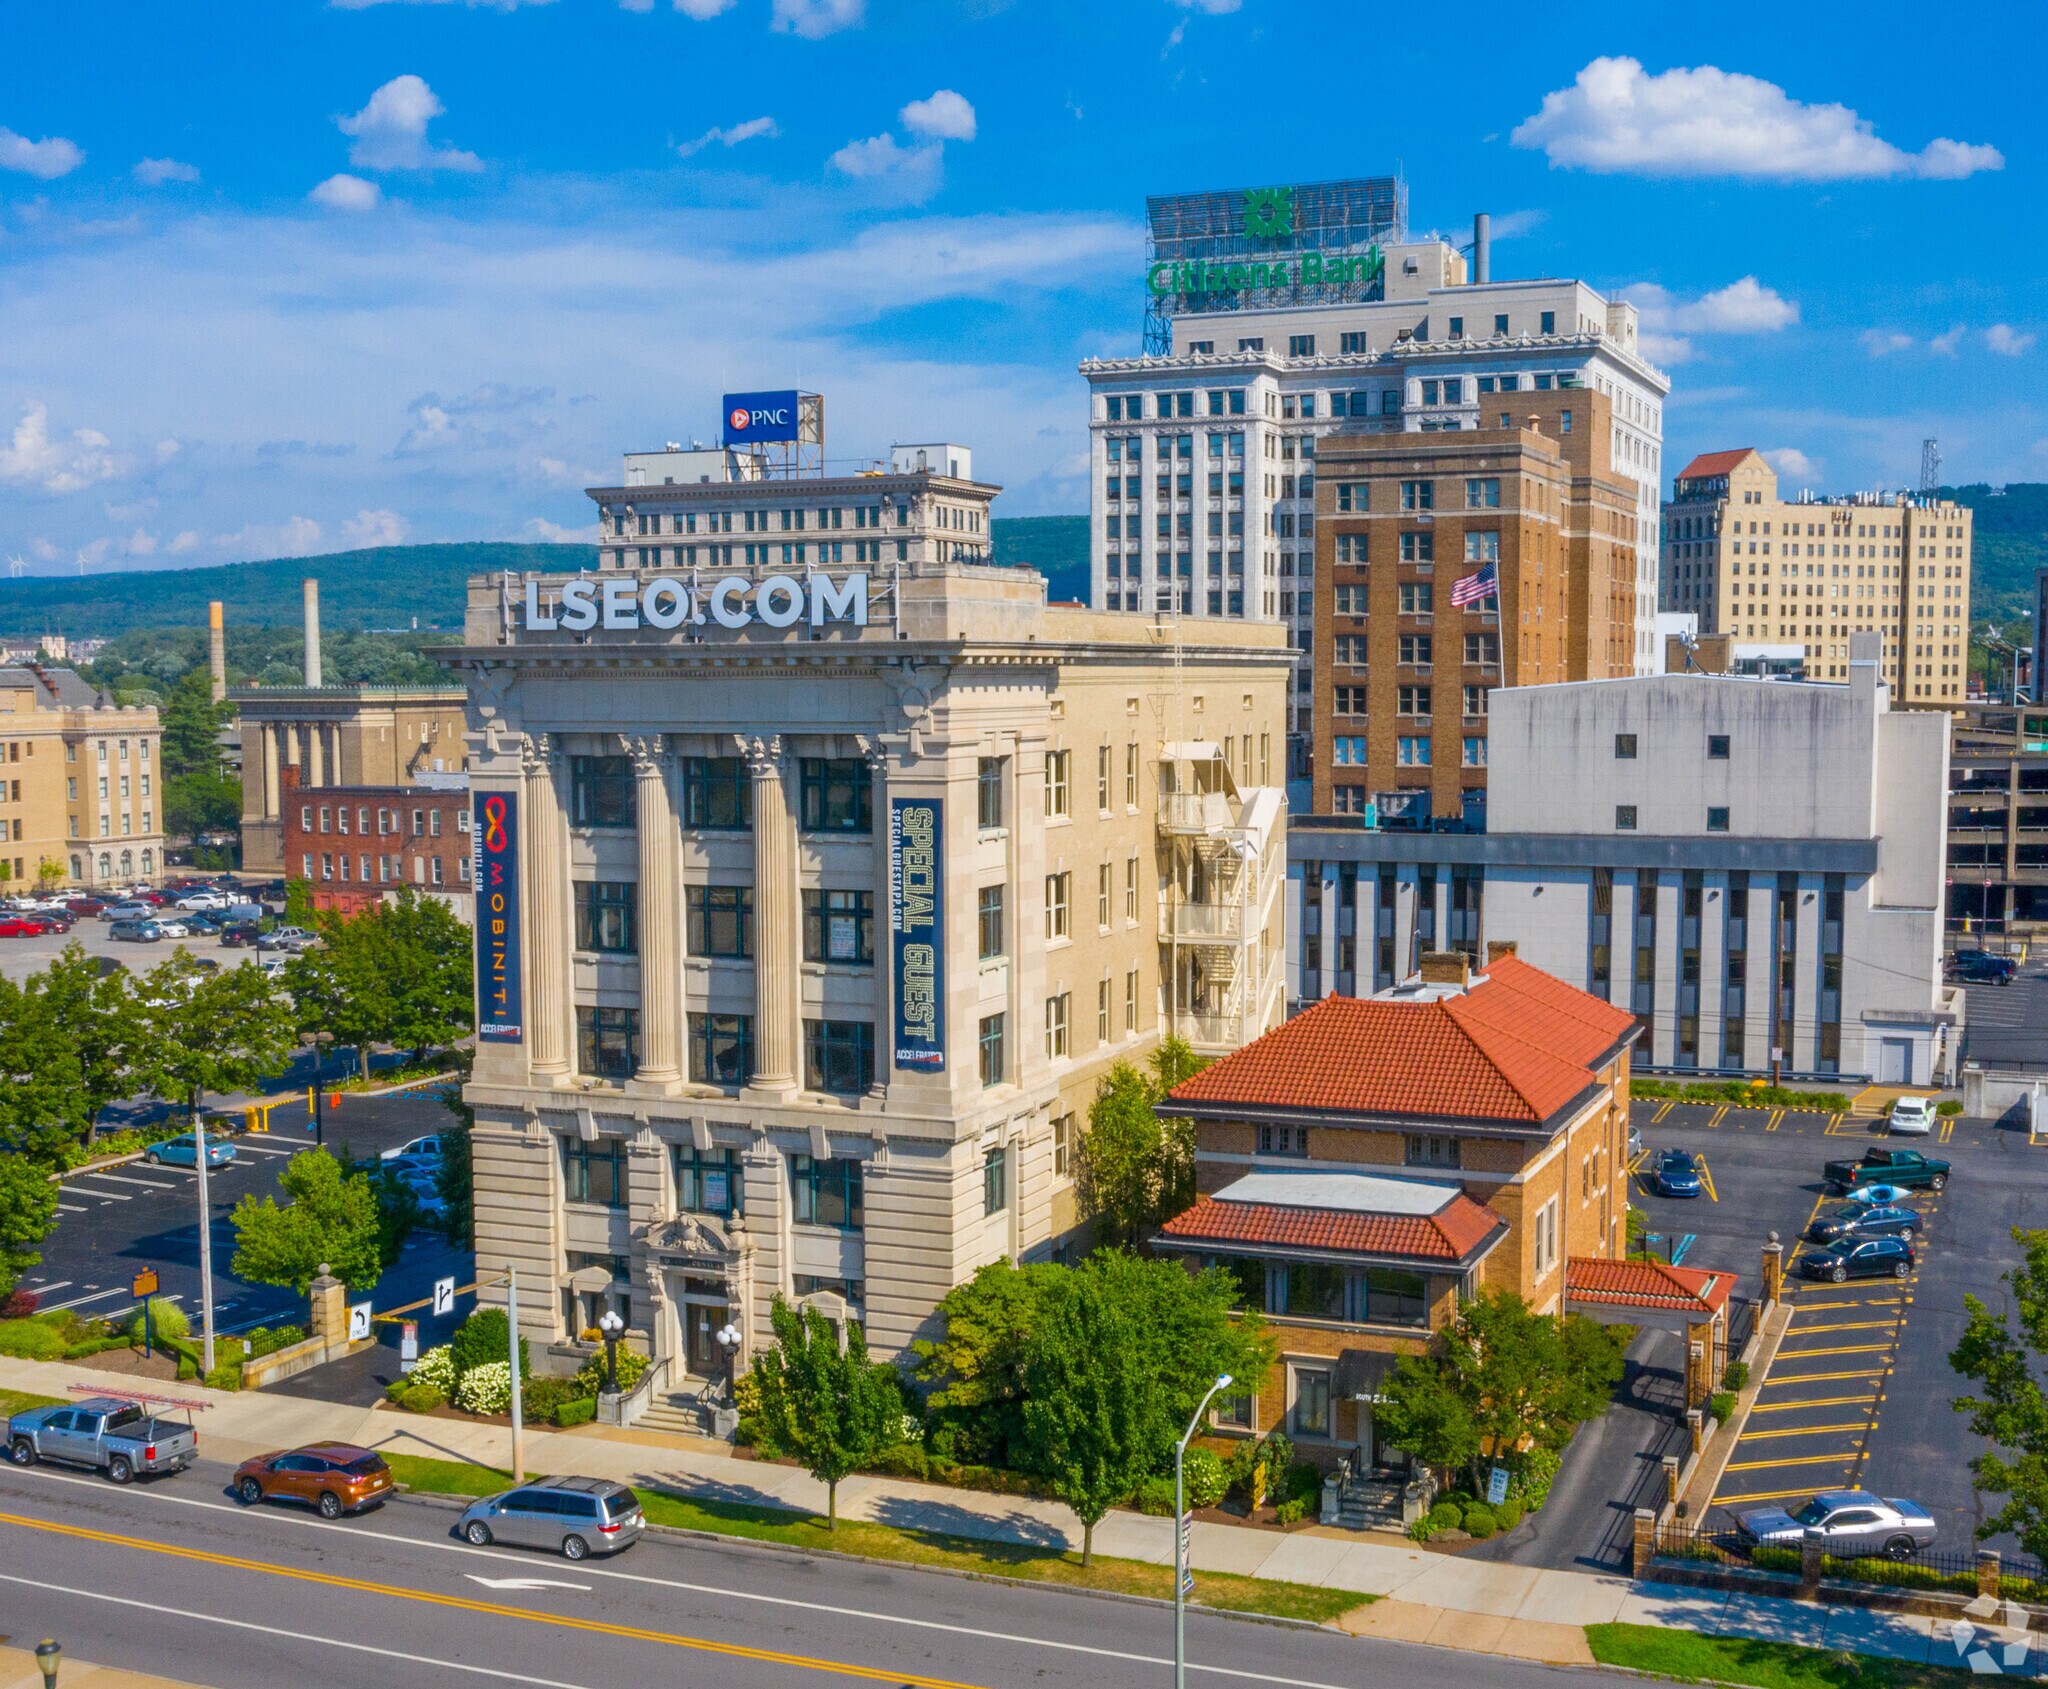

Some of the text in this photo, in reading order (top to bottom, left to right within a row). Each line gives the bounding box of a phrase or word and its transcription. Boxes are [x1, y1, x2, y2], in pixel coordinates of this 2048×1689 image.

[1147, 245, 1386, 295] Citizens Bank
[751, 408, 789, 426] PNC
[525, 573, 868, 631] LSEO.COM
[474, 822, 484, 892] MOBINITI.COM
[891, 808, 902, 930] SPECIALGUESTAPP.COM
[490, 861, 506, 1016] MOBINITI
[902, 807, 936, 1042] SPECIAL GUEST
[352, 1327, 366, 1337] ONLY
